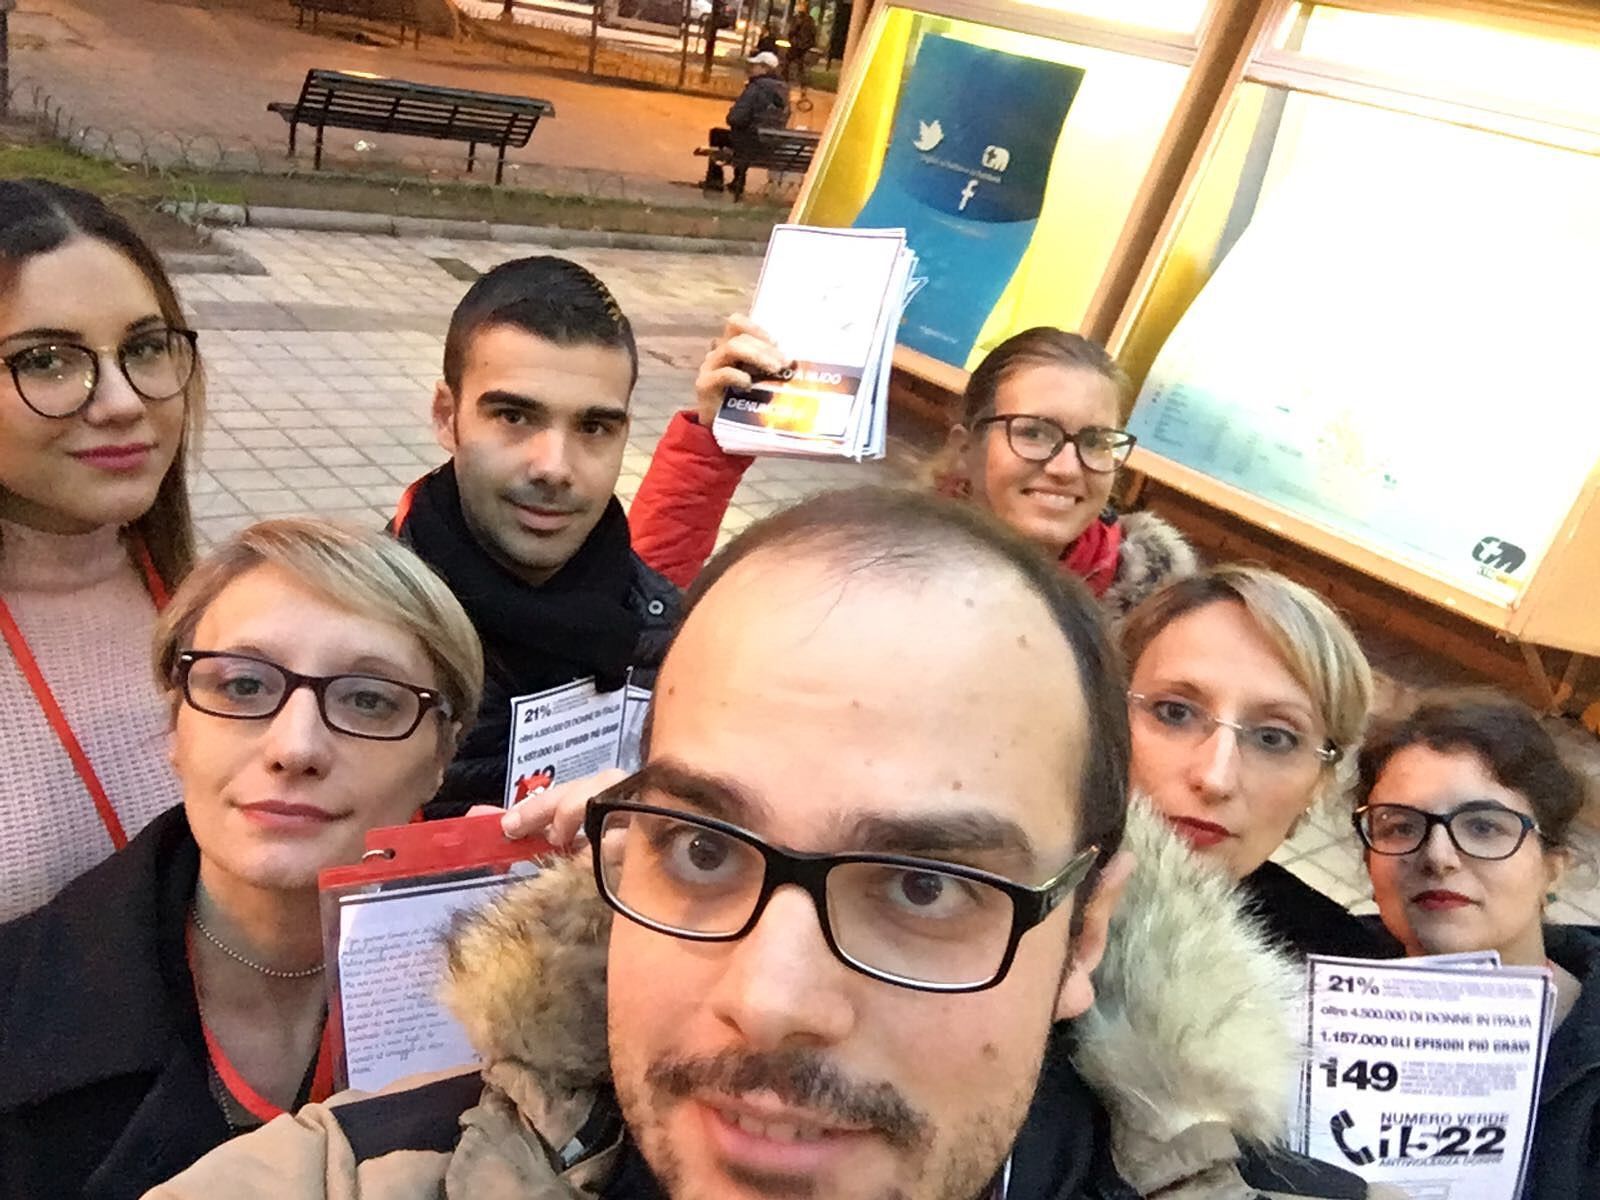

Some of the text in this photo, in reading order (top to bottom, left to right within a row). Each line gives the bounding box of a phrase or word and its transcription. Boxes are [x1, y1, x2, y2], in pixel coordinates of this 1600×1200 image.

[524, 703, 552, 724] 21%
[1328, 975, 1380, 995] 21%
[1319, 1057, 1399, 1092] 149
[1381, 1112, 1509, 1127] NUMERO VERDE
